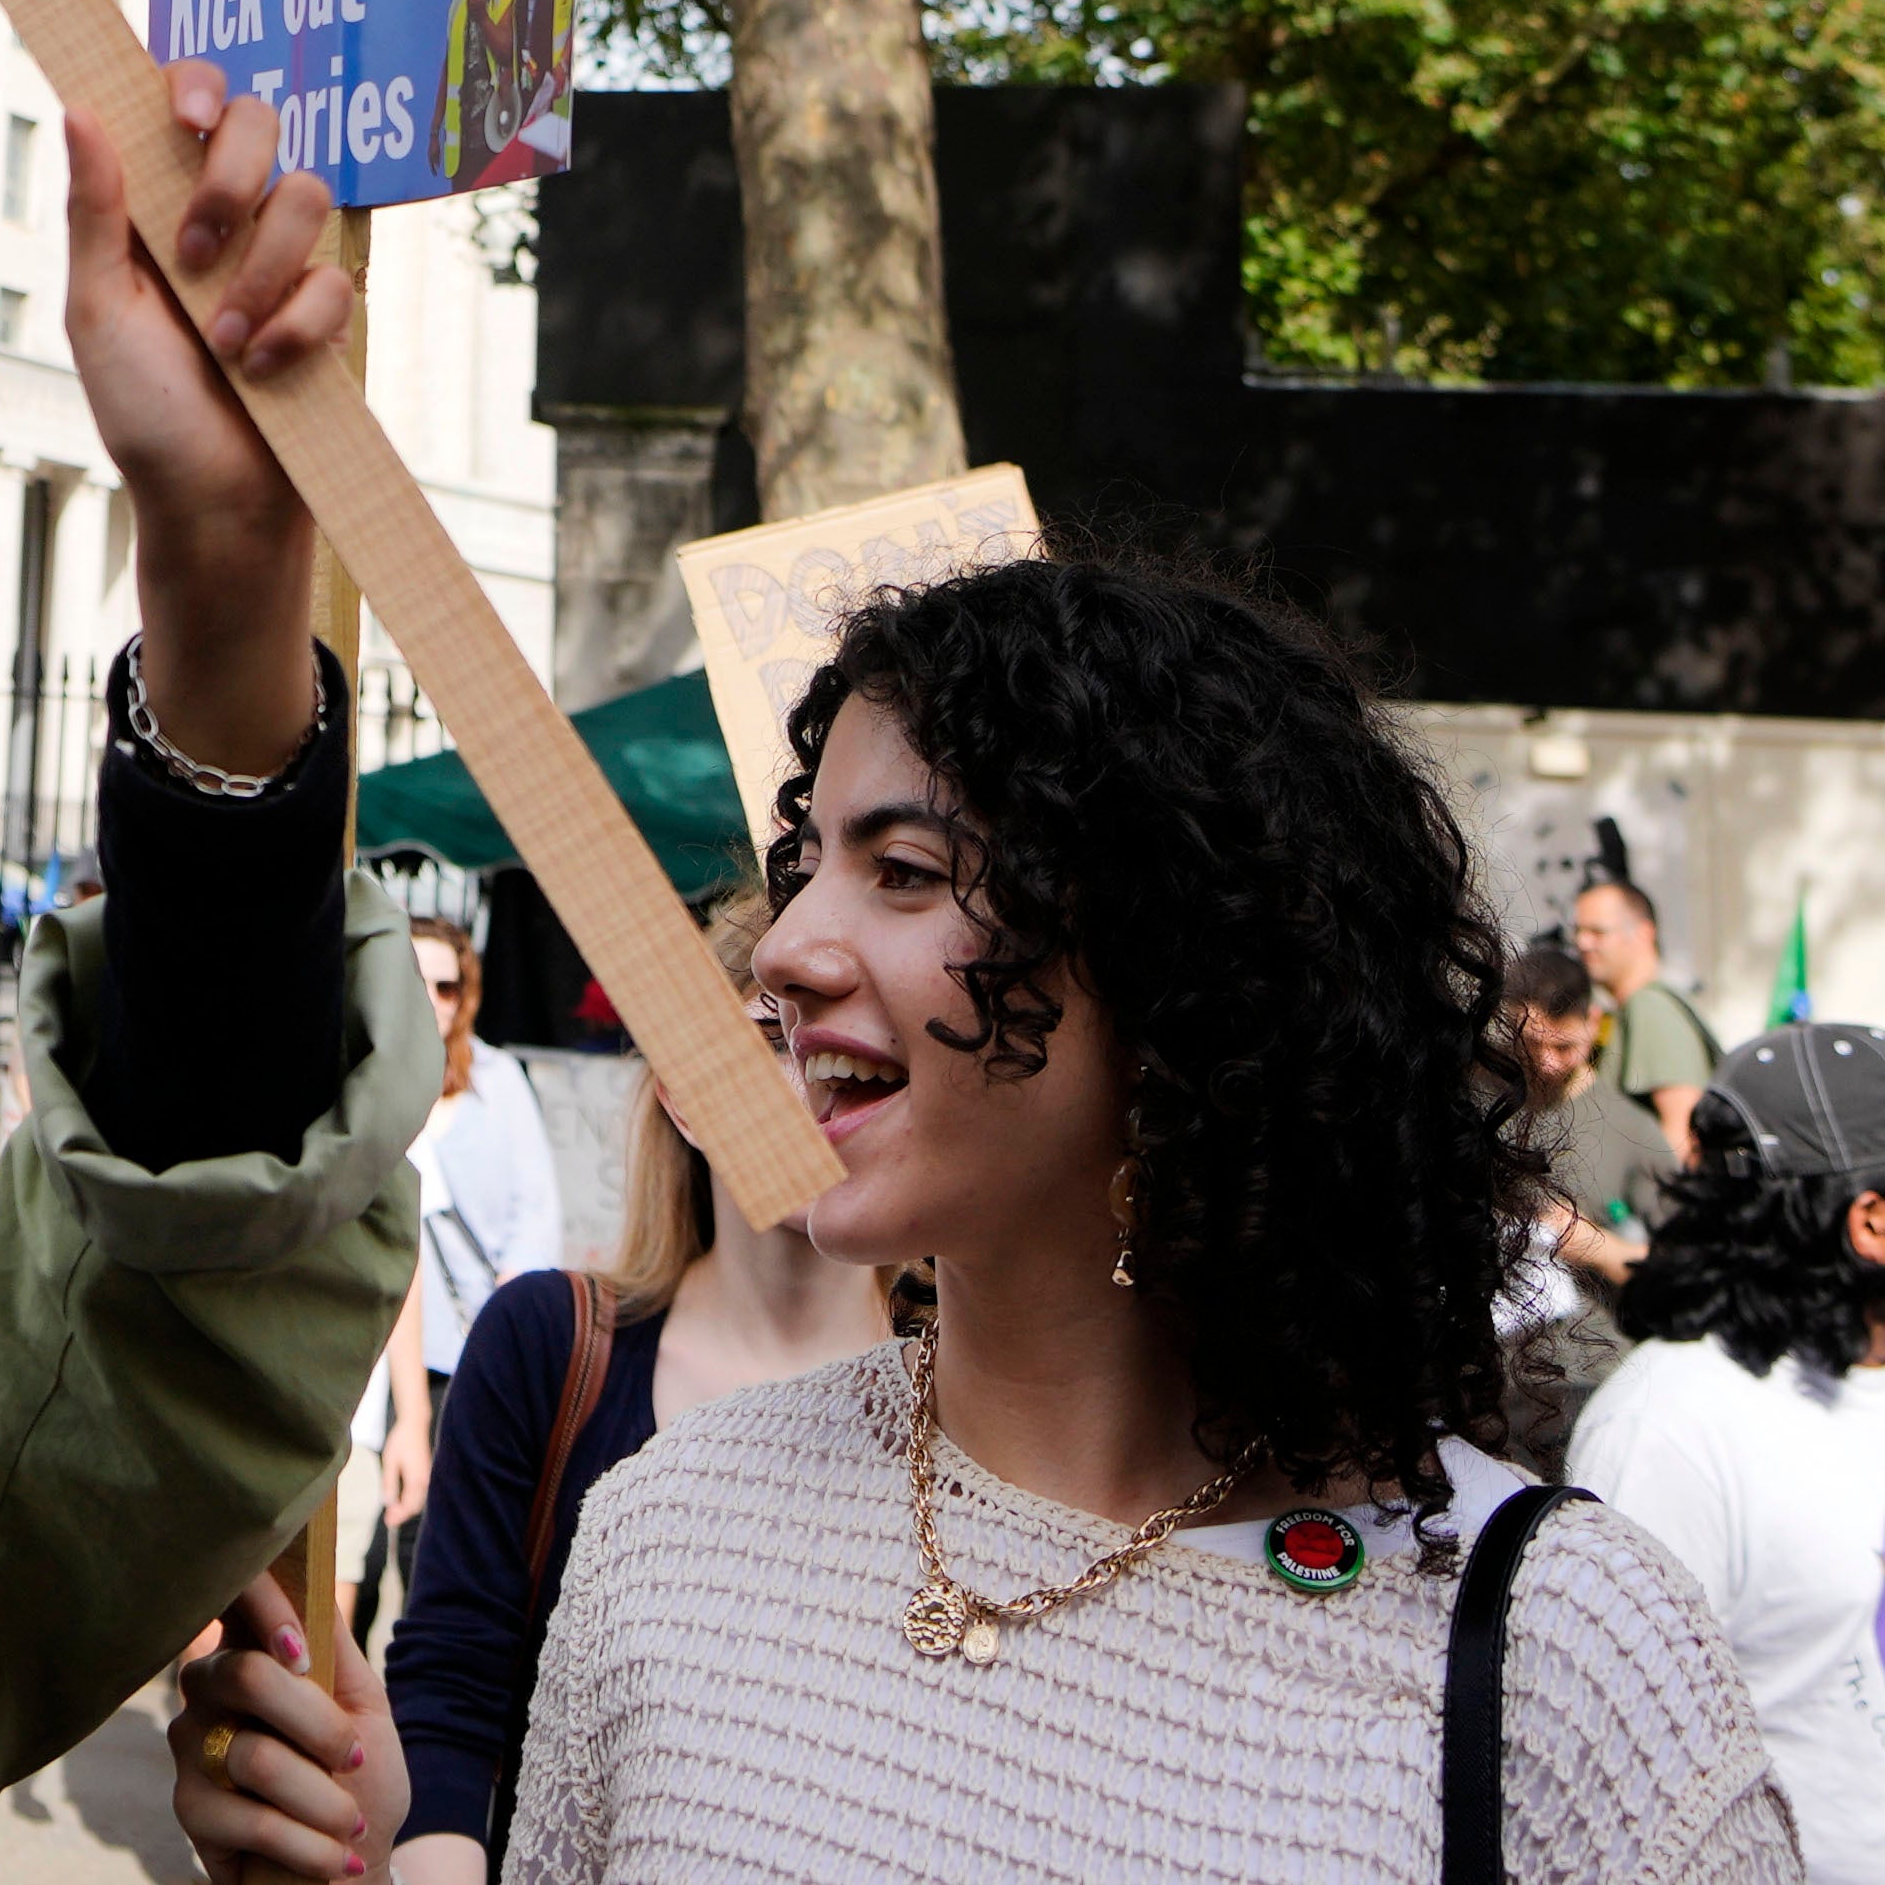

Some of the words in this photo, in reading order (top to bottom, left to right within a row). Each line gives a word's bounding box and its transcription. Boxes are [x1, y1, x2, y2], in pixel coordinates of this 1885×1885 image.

[1275, 1513, 1334, 1534] FREEDOM
[1335, 1524, 1355, 1546] FOR
[1276, 1551, 1341, 1579] PALESTINE
